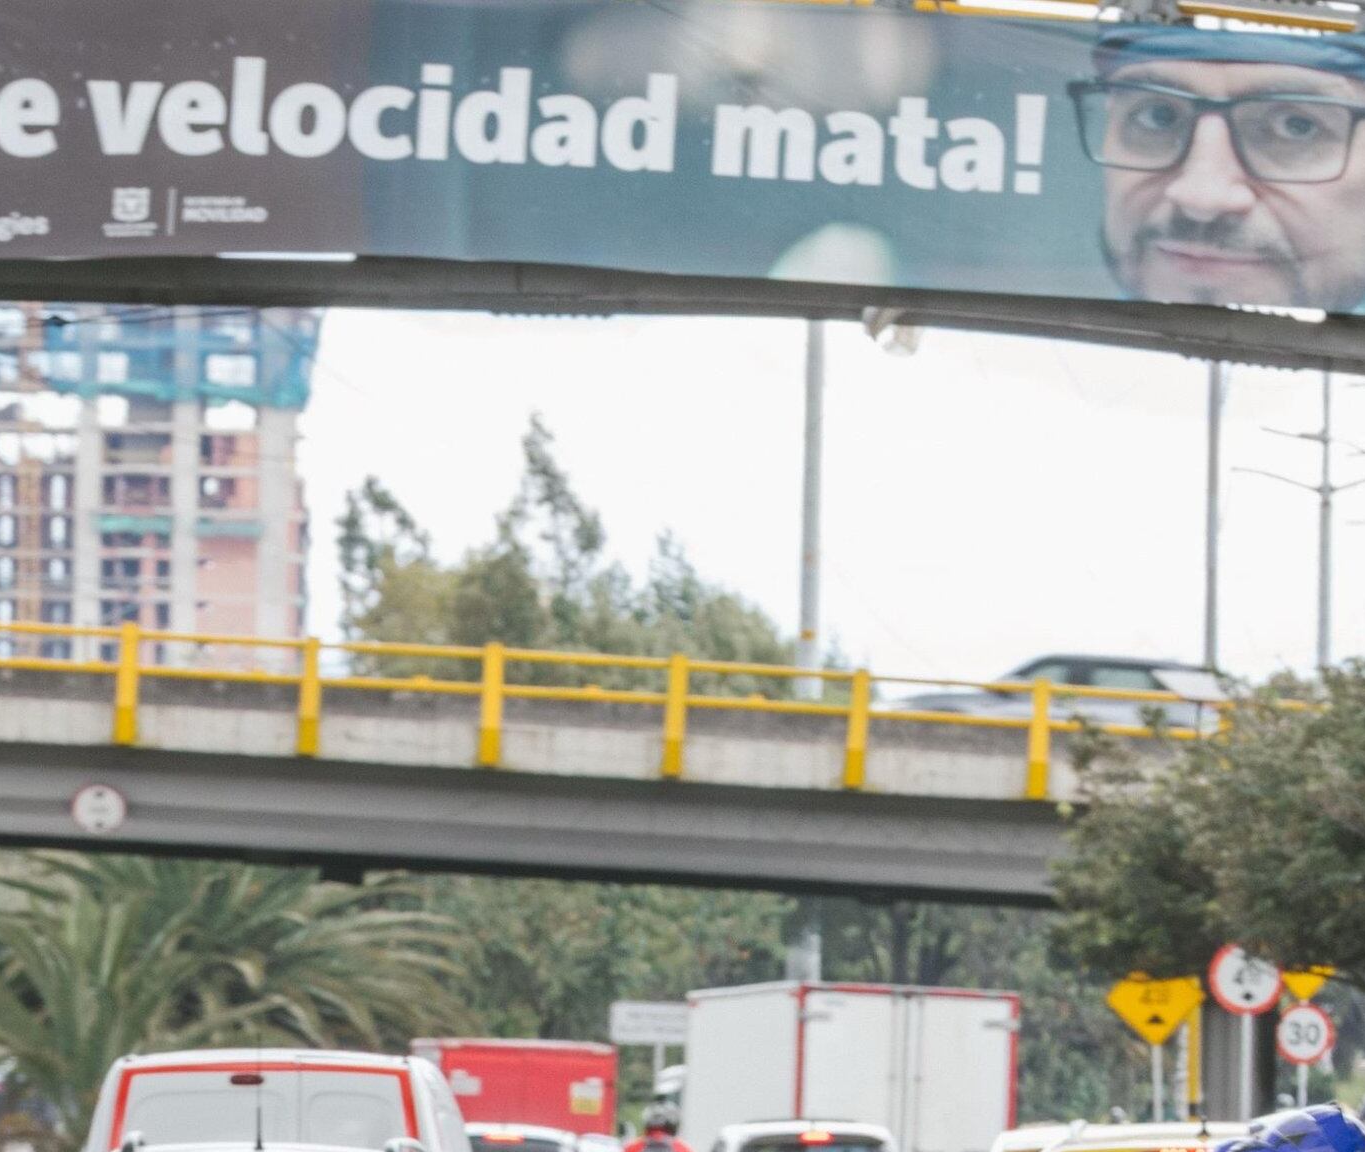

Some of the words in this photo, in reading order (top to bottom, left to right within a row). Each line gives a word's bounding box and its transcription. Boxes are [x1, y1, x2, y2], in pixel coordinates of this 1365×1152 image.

[87, 56, 678, 173] velocidad
[711, 93, 1048, 196] mata!
[1289, 1022, 1321, 1045] 30
